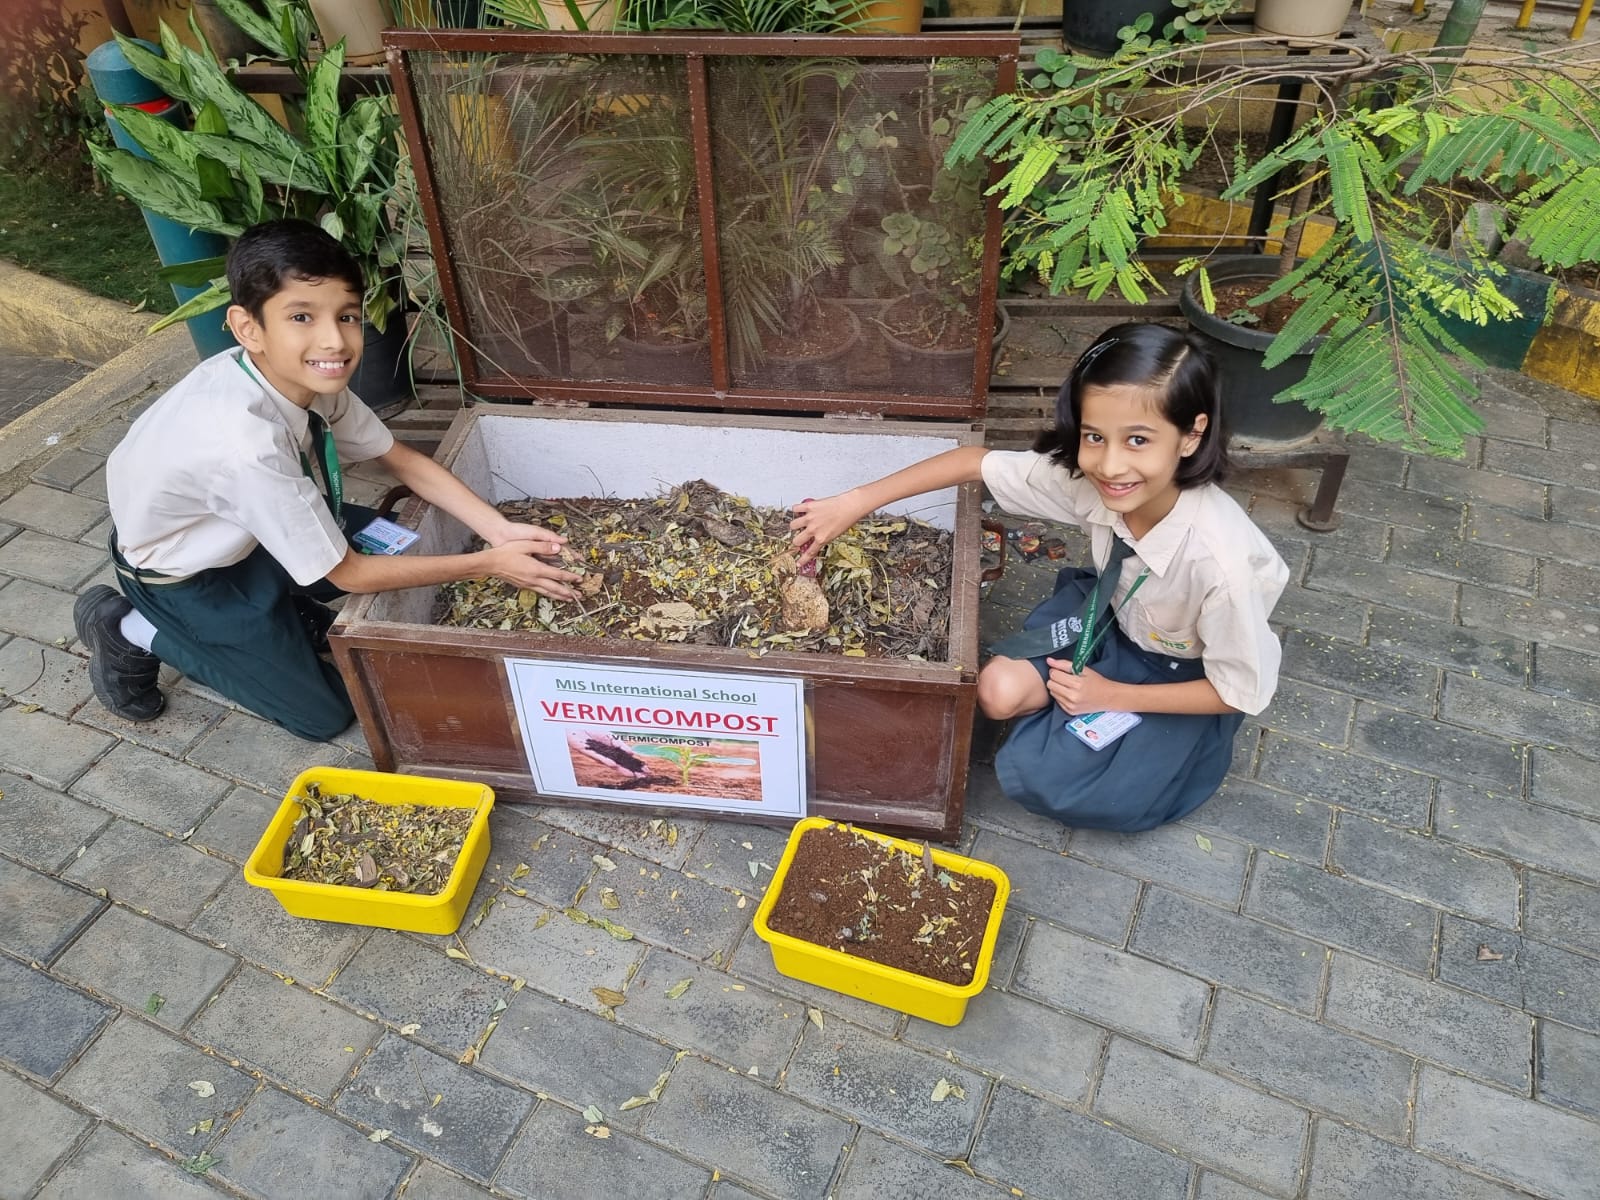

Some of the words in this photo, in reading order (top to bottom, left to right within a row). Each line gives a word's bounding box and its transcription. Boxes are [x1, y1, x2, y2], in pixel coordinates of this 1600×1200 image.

[556, 678, 586, 691] MIS
[591, 681, 697, 699] International
[702, 687, 756, 703] School
[540, 700, 779, 733] VERMICOMPOST
[612, 734, 712, 747] VERMICOMPOST
